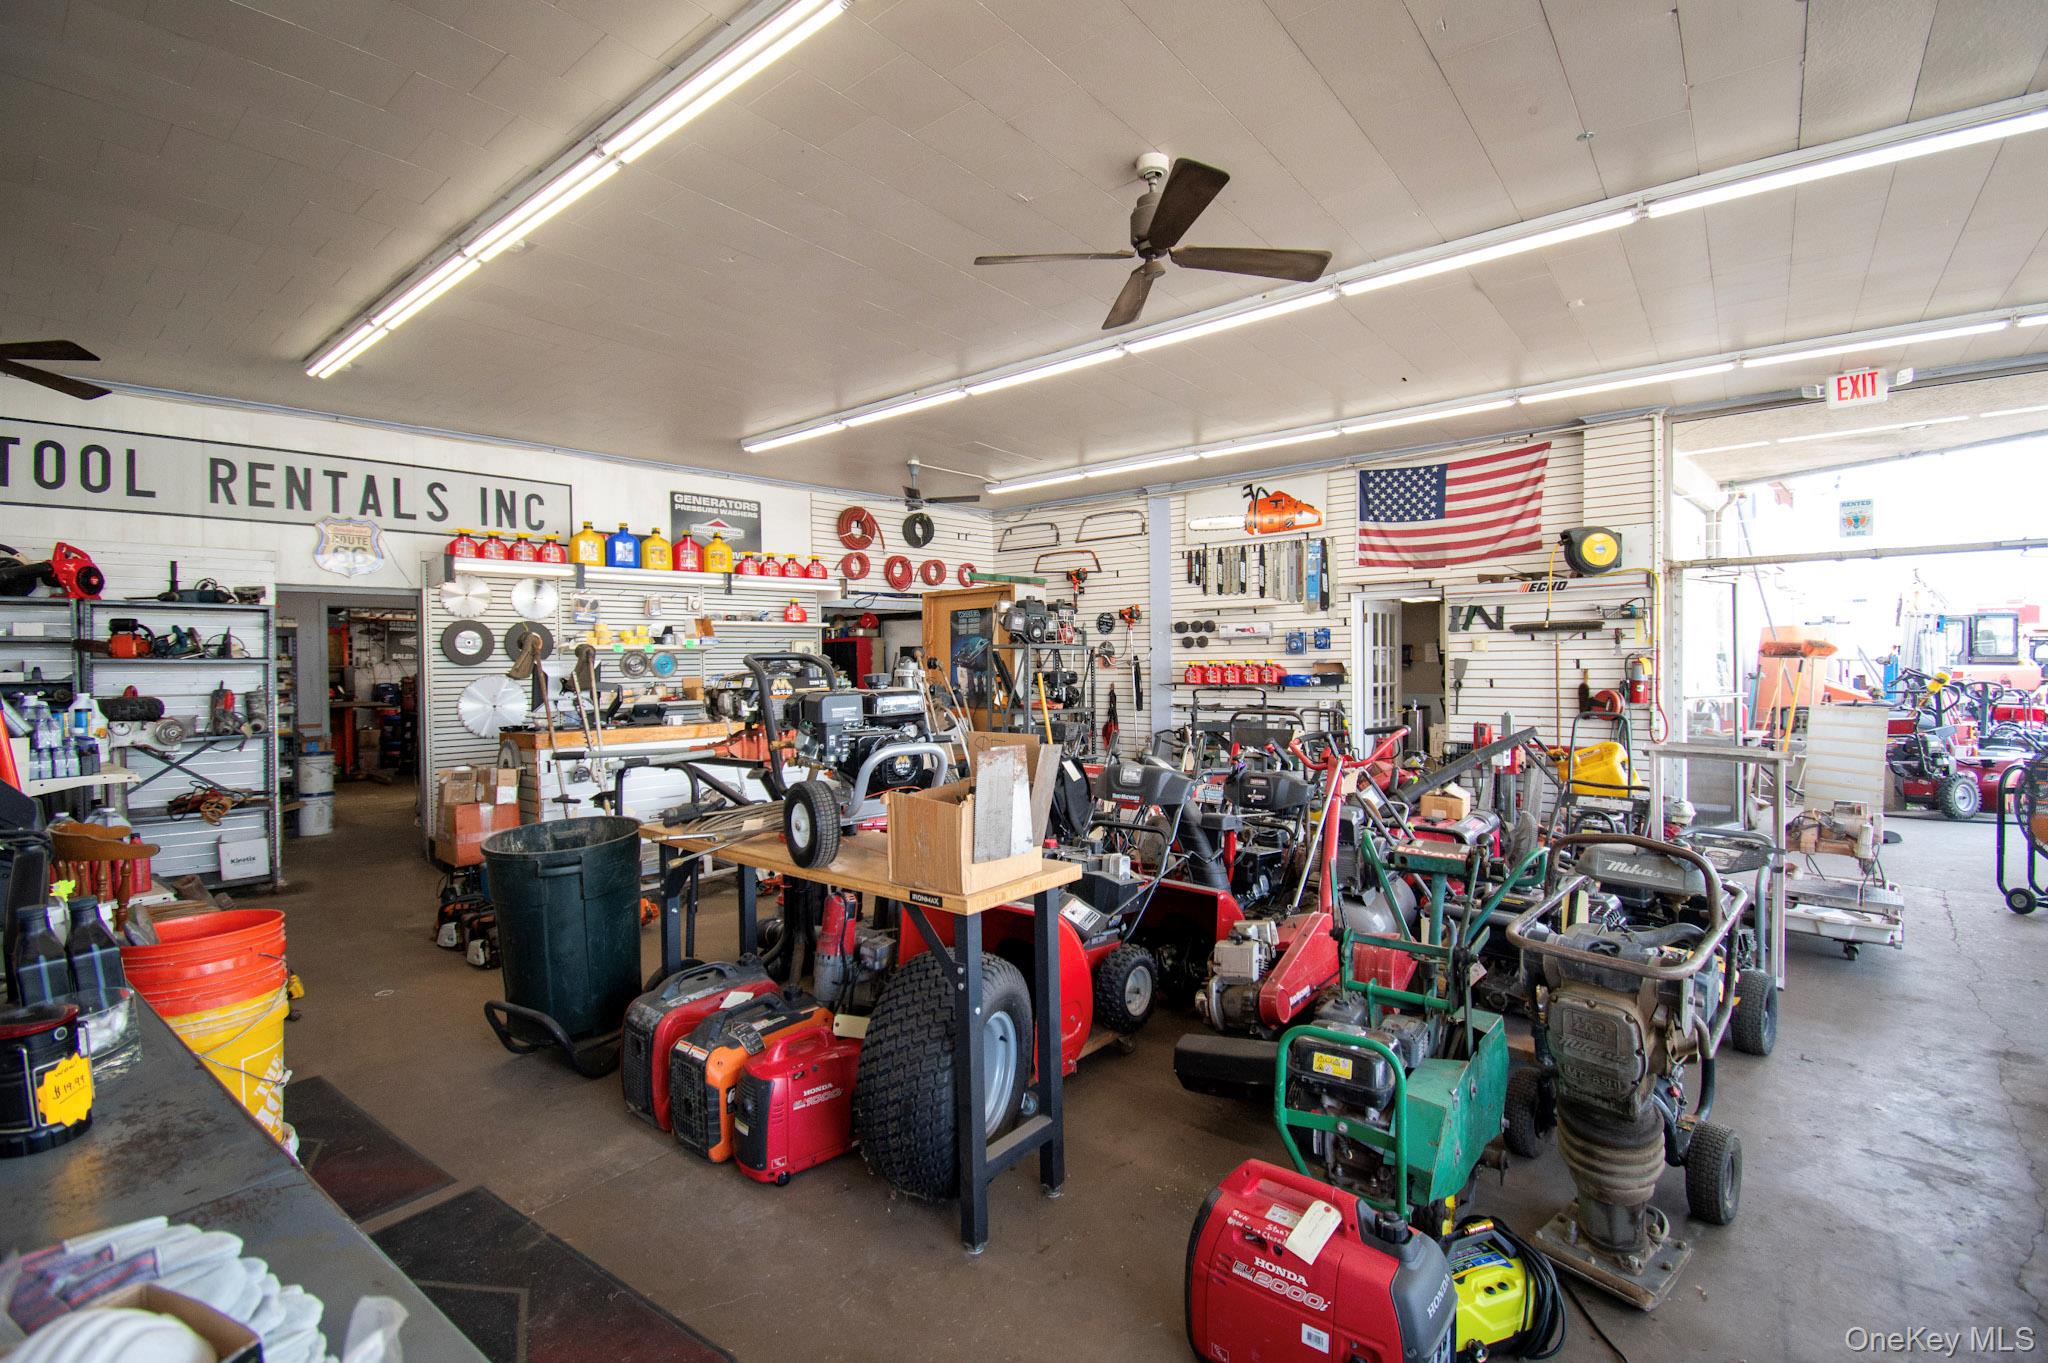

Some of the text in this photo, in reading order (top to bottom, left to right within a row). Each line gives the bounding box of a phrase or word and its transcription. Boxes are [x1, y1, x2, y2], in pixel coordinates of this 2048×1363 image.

[1836, 371, 1879, 402] EXIT
[0, 436, 157, 499] TOOL
[208, 456, 450, 523] RENTALS
[673, 493, 759, 512] GENERATORS
[674, 503, 758, 519] PRESSURE WASHERS
[1528, 580, 1569, 593] ECHO
[911, 893, 940, 905] IRONMAX
[803, 1082, 833, 1097] HONDA
[1254, 1256, 1309, 1287] HONDA
[1426, 1273, 1451, 1320] HONDA
